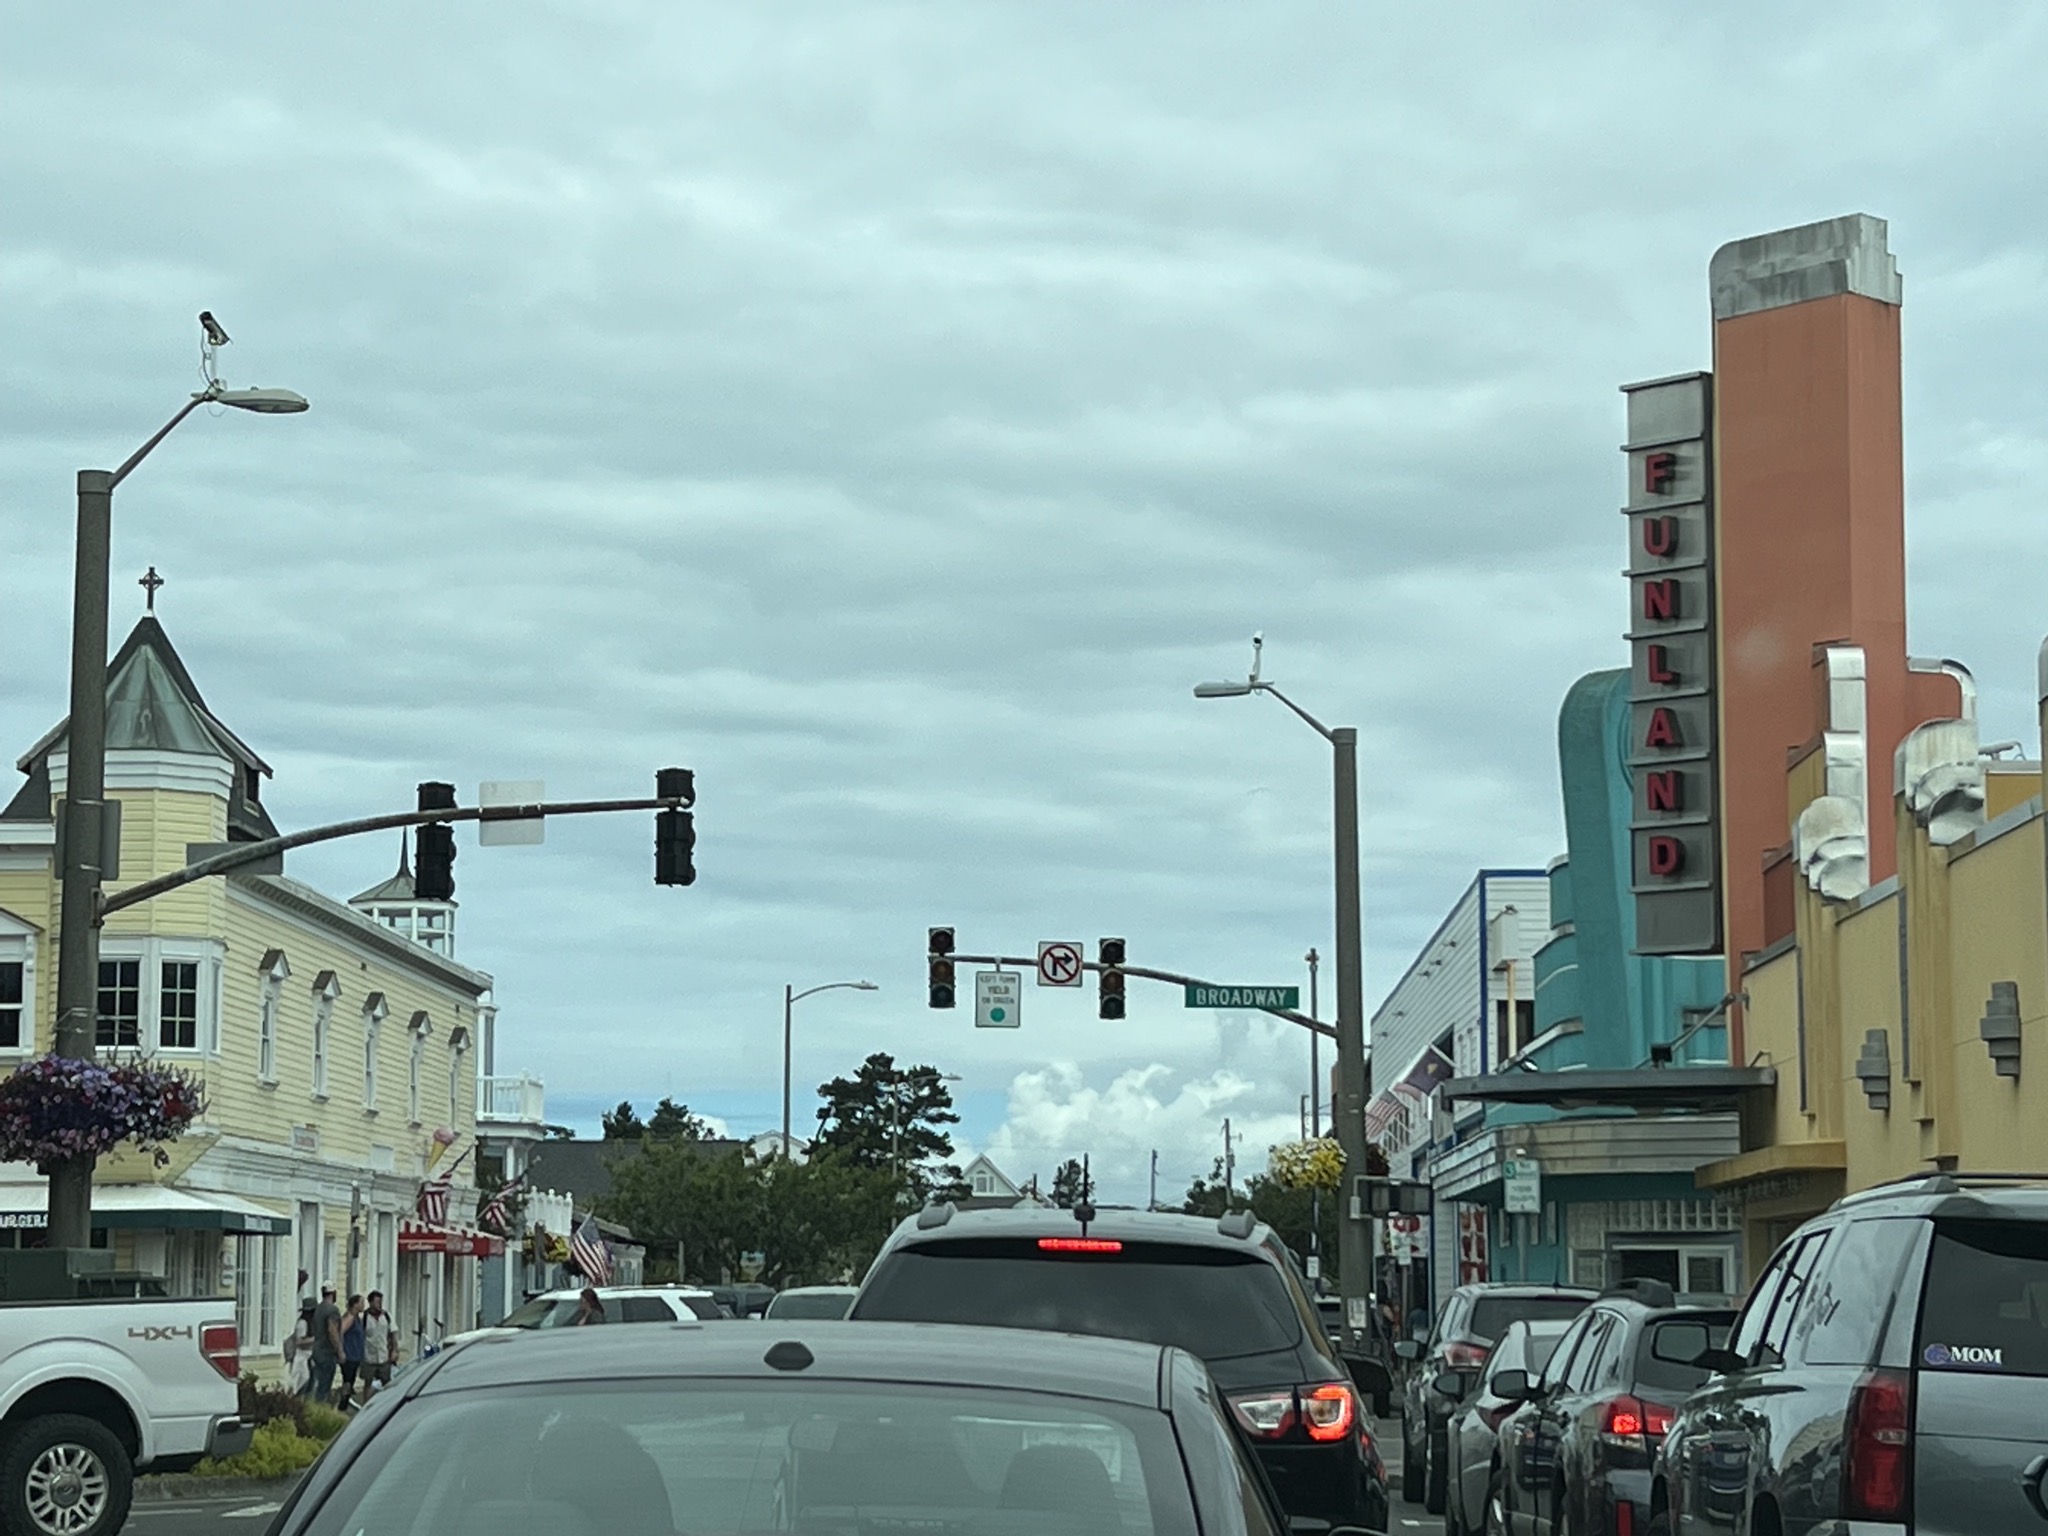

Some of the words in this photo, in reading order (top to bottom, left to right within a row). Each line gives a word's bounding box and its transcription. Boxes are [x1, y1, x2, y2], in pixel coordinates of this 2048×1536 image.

[1643, 452, 1684, 877] FUNLAND
[1196, 988, 1287, 1006] BROADWAY
[1950, 1346, 2002, 1364] MOM
